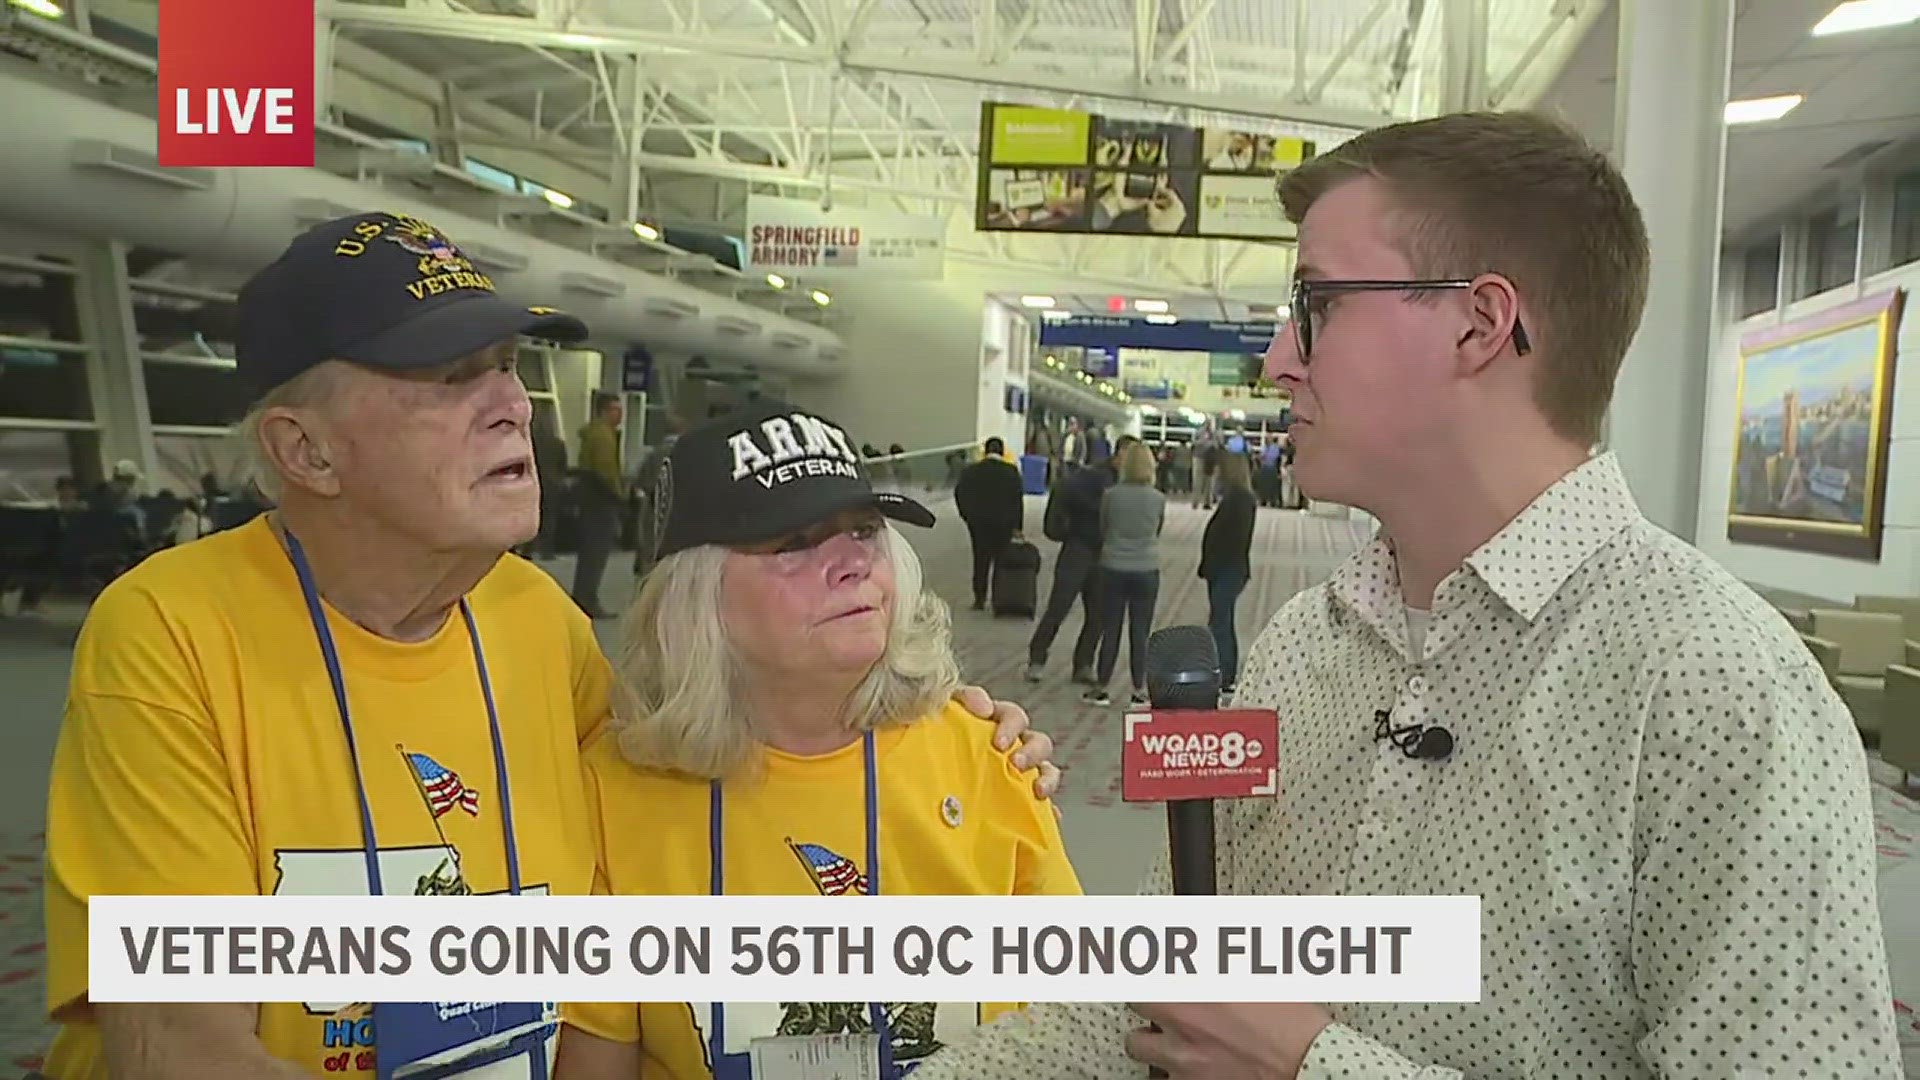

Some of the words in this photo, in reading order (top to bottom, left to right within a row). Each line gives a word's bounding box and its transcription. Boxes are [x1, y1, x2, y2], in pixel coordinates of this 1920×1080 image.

[752, 225, 860, 246] SPRINGFIELD
[751, 246, 820, 266] ARMORY
[728, 413, 857, 481] ARMY
[756, 458, 859, 489] VETERAN
[1141, 734, 1219, 754] WQAD
[1163, 752, 1219, 768] NEWS
[1220, 731, 1246, 767] 8
[324, 1018, 375, 1047] HO
[324, 1052, 350, 1071] of
